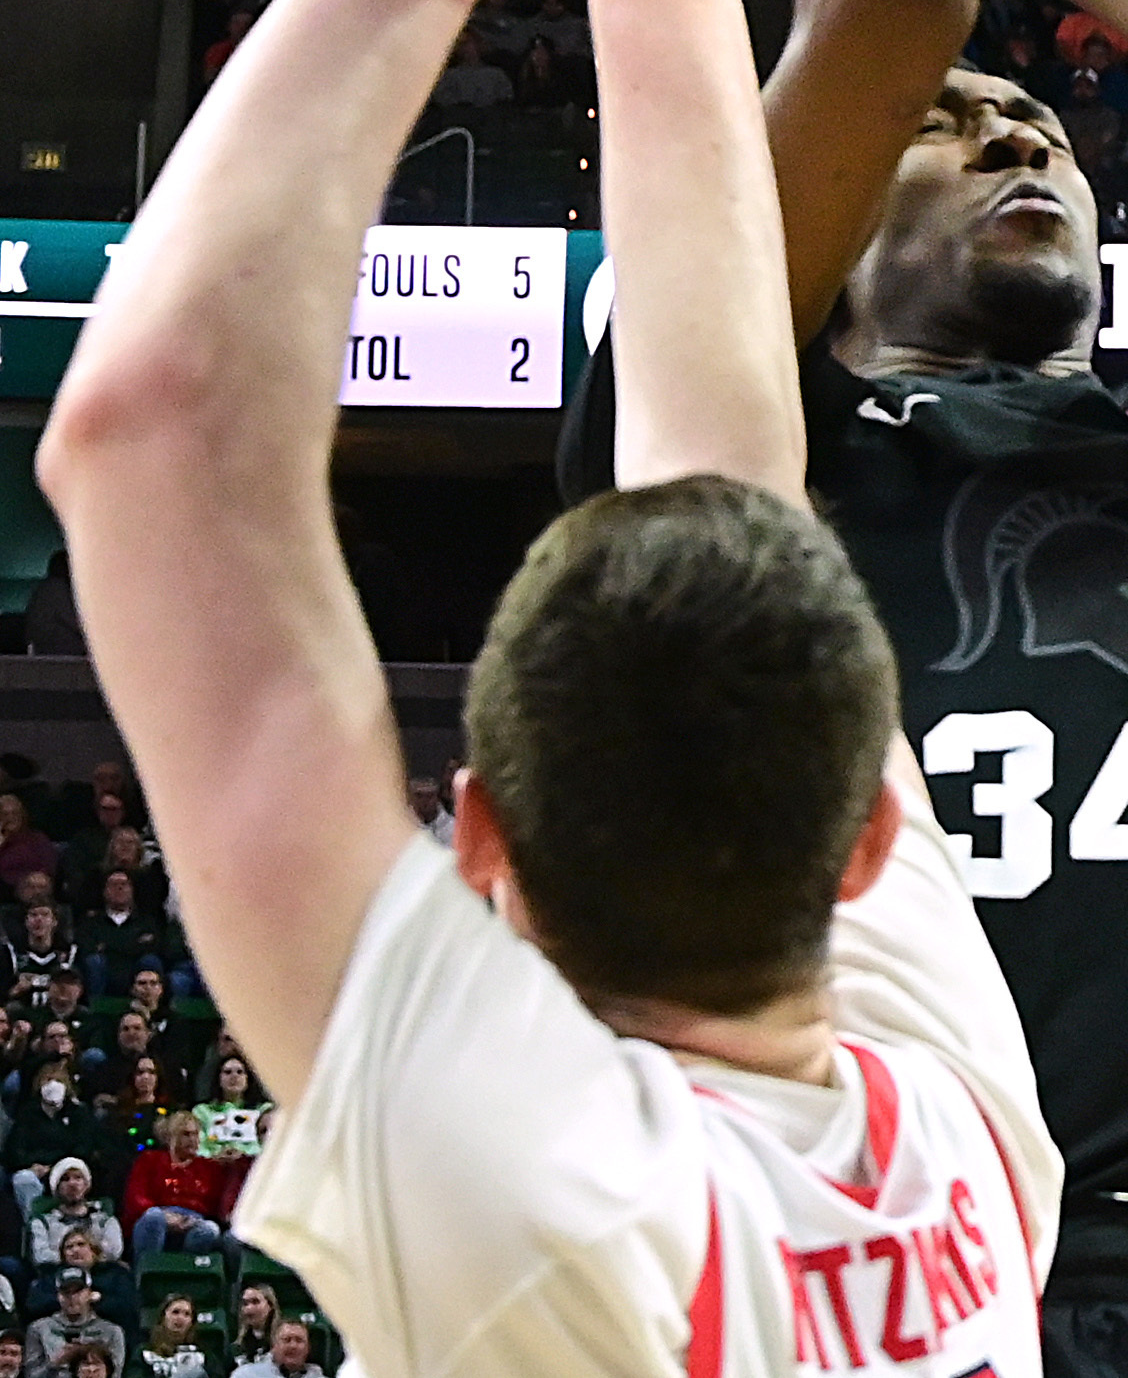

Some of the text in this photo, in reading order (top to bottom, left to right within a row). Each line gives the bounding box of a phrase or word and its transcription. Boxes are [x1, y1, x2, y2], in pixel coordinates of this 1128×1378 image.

[356, 254, 531, 299] OULS 5
[350, 335, 530, 383] TOL 2
